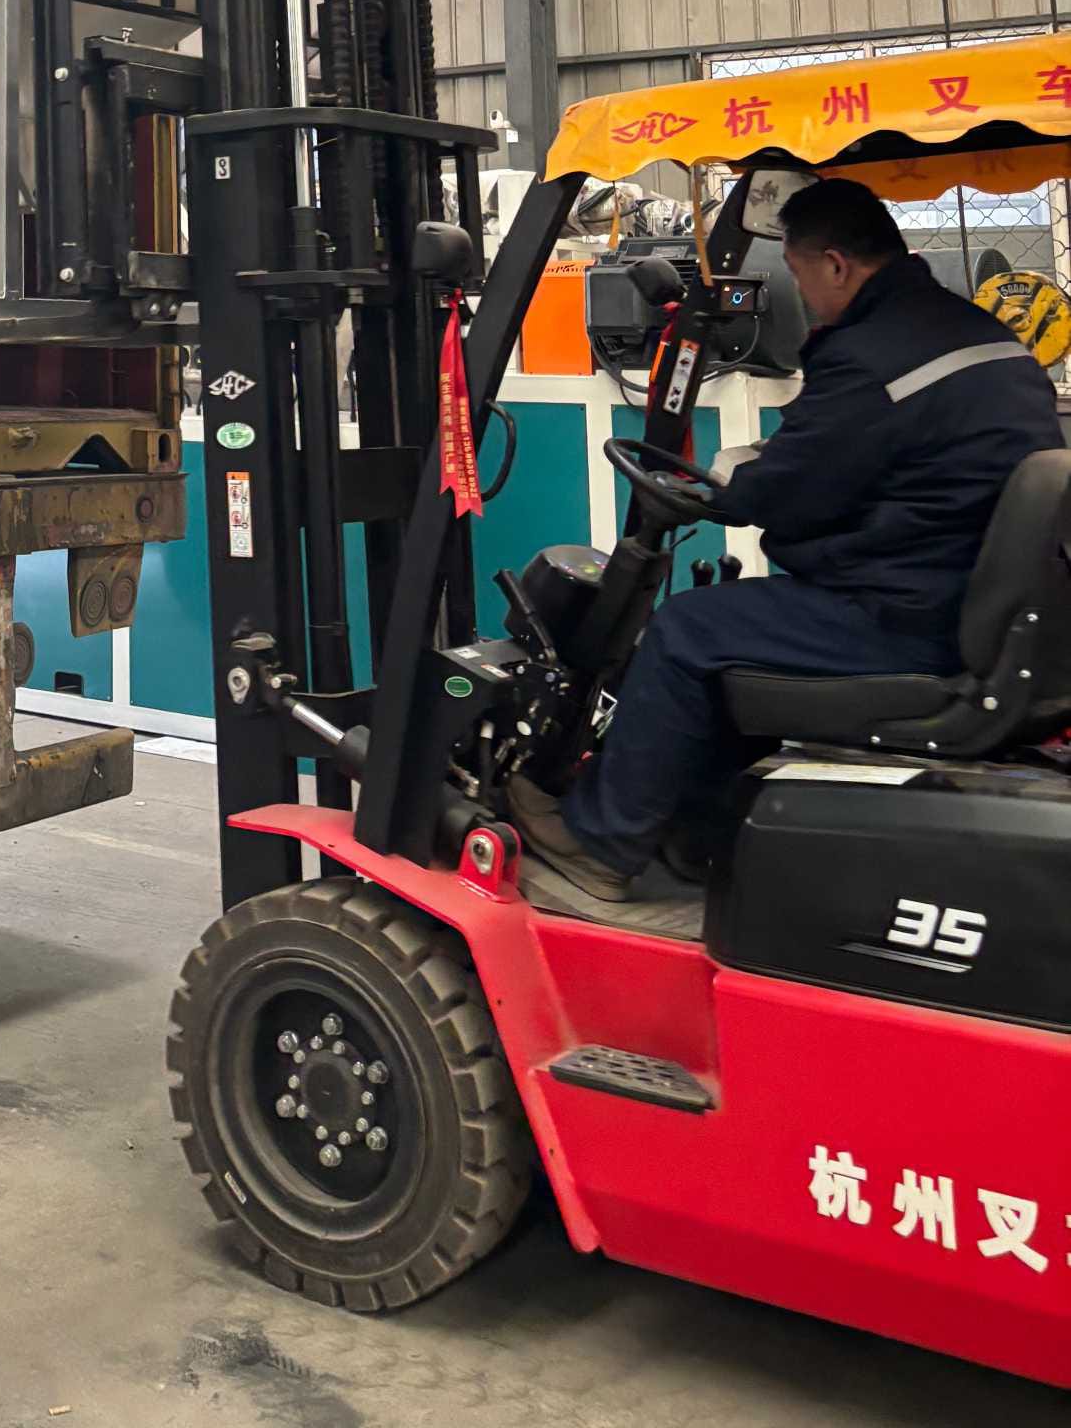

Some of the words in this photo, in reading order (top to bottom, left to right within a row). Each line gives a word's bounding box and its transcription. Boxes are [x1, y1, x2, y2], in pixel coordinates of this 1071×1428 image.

[723, 65, 1071, 139] 杭州叉车
[886, 898, 988, 958] 35
[808, 1144, 1071, 1274] 杭州叉
